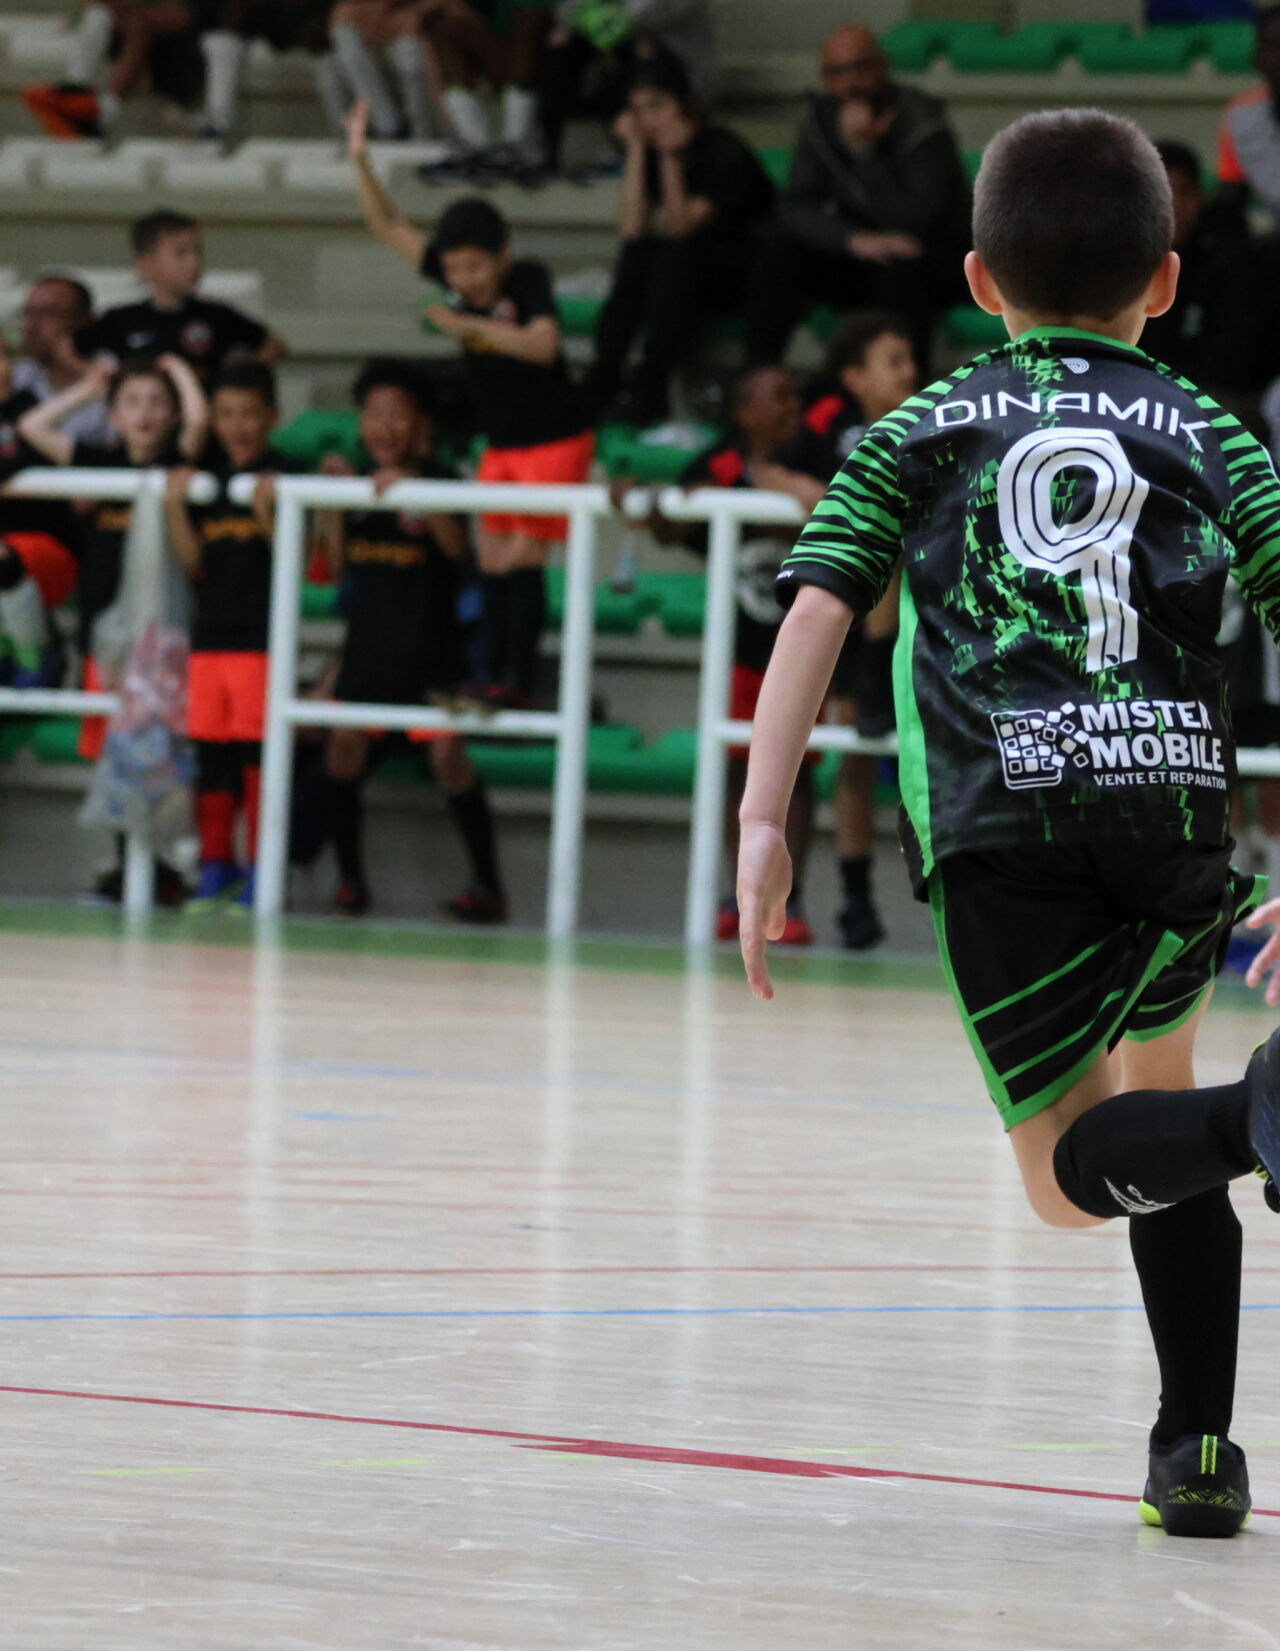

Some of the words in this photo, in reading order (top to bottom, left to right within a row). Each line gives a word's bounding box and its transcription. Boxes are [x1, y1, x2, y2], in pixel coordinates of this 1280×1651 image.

[934, 390, 1212, 455] DINAMIK
[997, 426, 1150, 673] 9
[1079, 699, 1213, 732] MISTER
[1088, 732, 1226, 773] MOBILE
[1092, 772, 1146, 787] VENTE
[1149, 771, 1168, 784] ET
[1170, 771, 1228, 791] REPARATION
